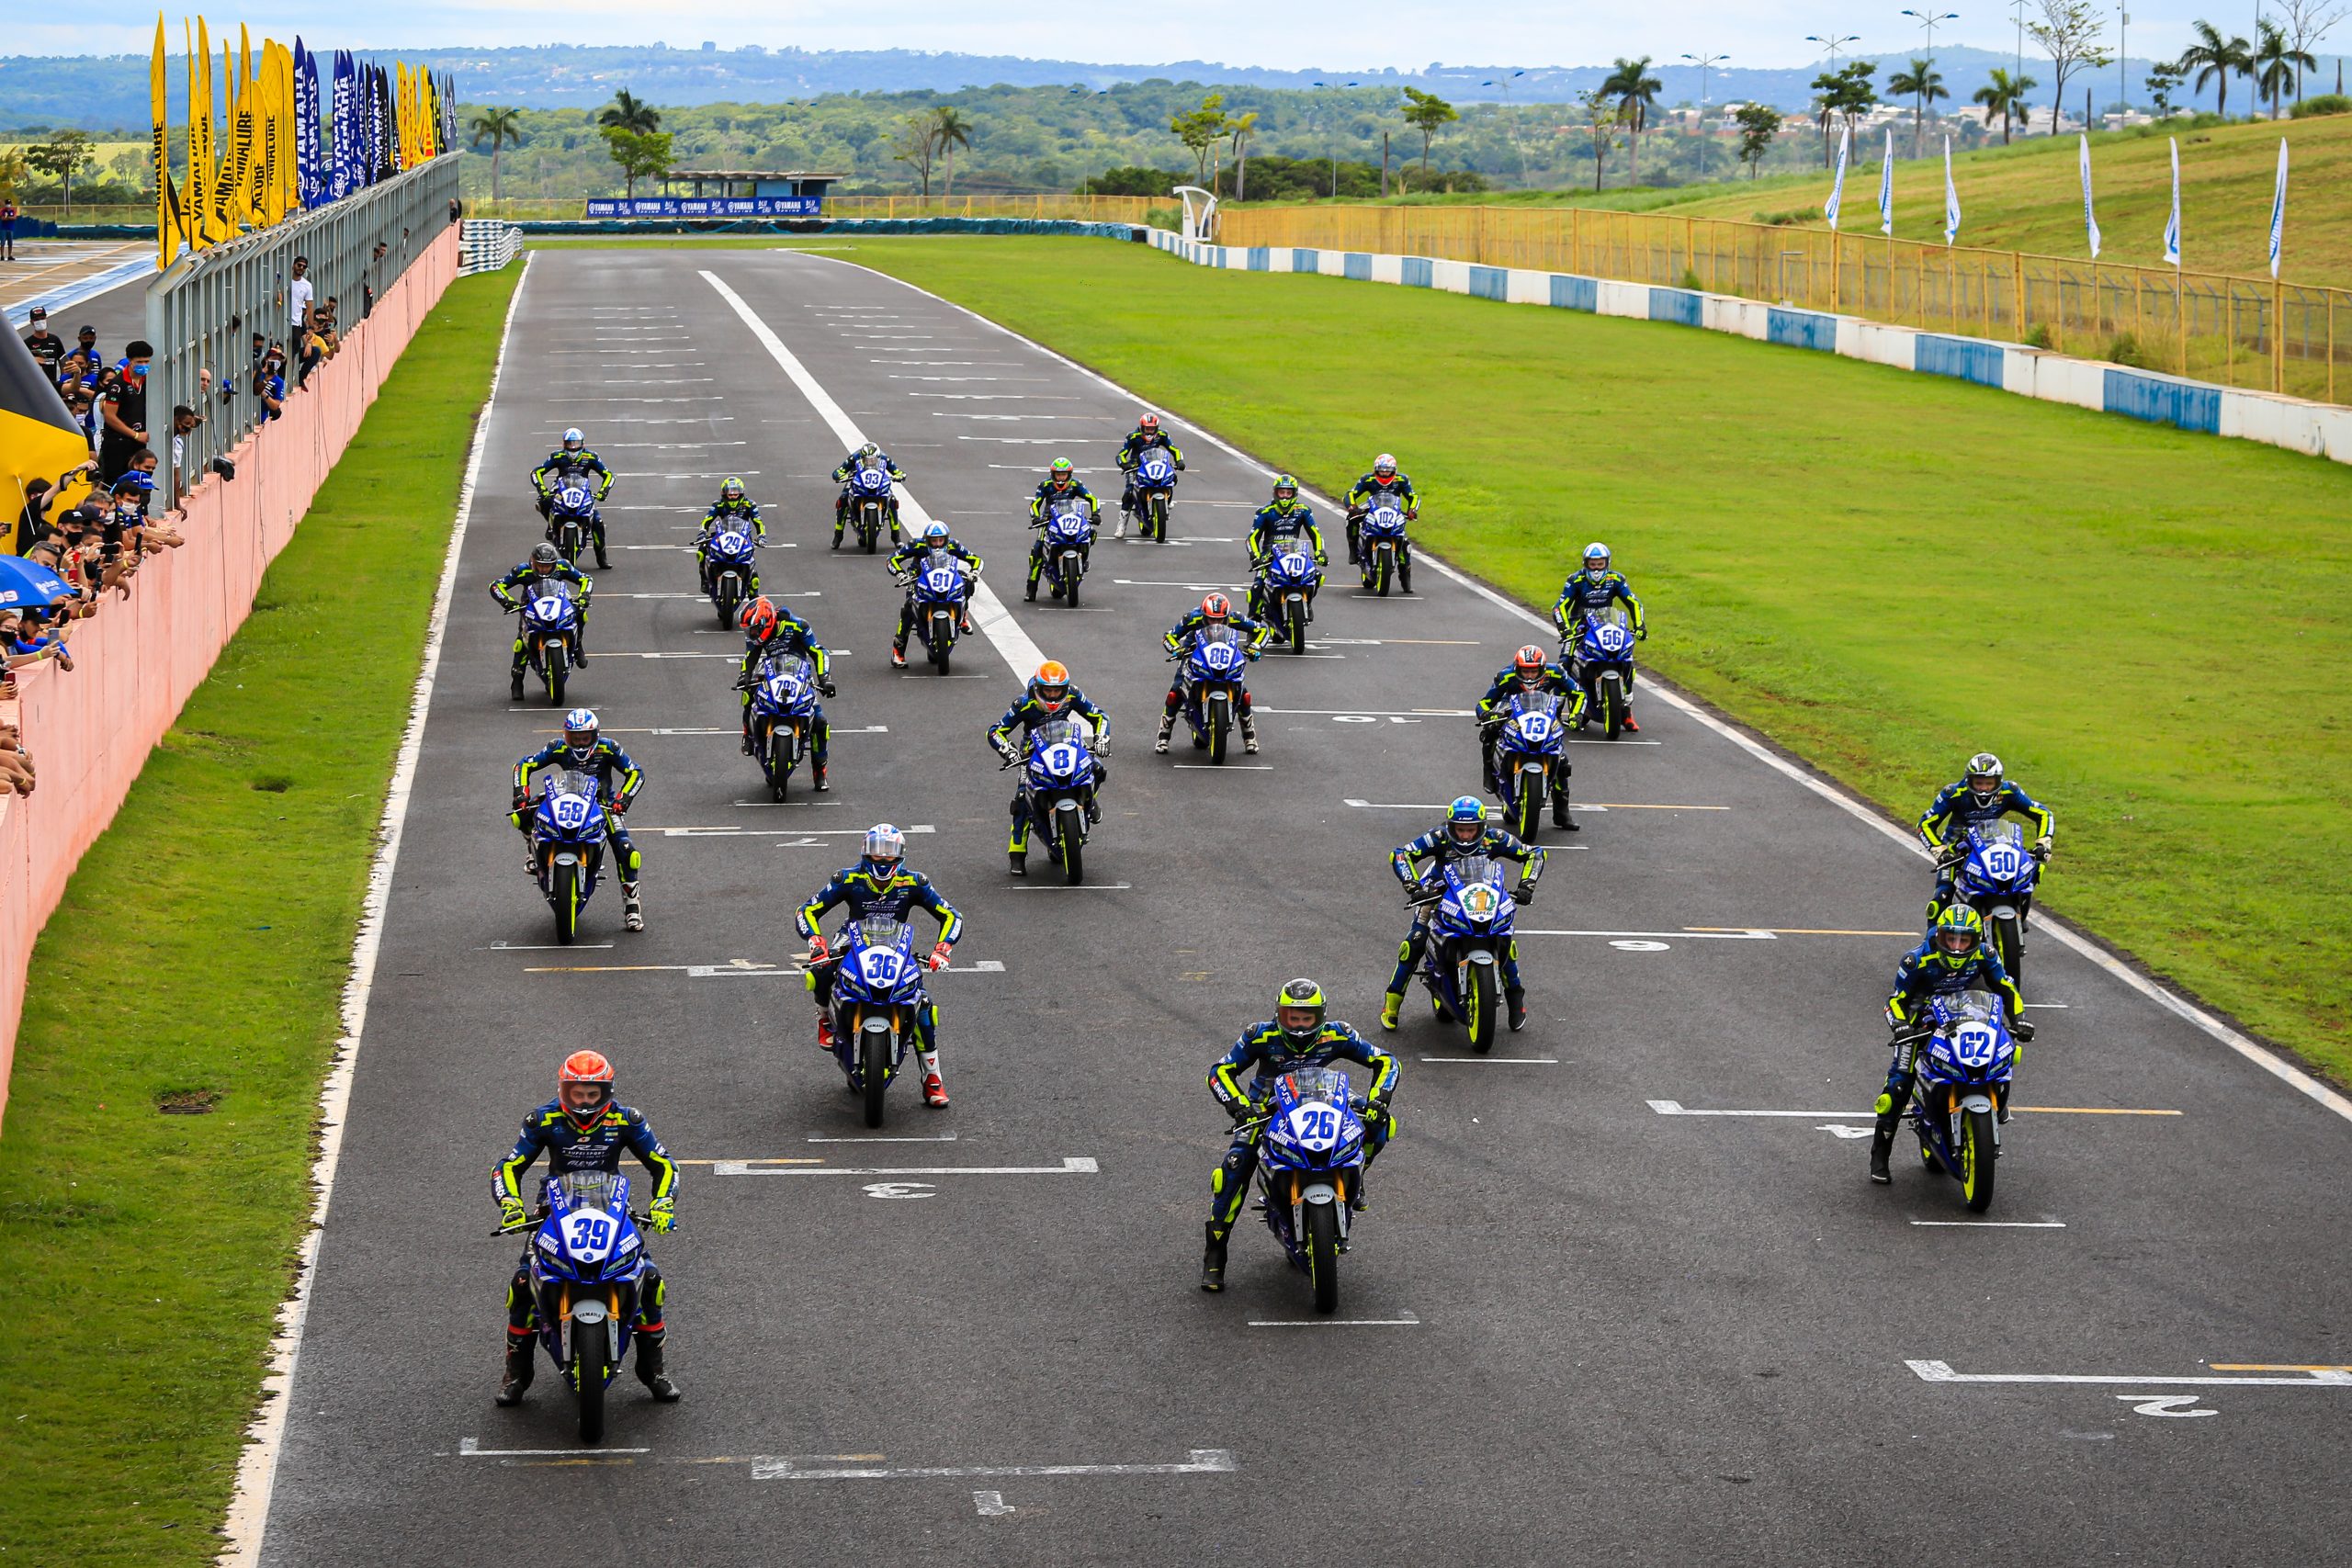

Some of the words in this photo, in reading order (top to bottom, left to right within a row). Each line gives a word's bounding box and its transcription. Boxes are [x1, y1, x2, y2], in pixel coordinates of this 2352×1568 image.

[641, 202, 661, 210] YAMAHA
[687, 202, 707, 210] YAMAHA
[734, 202, 753, 210] YAMAHA
[865, 473, 879, 484] 93
[1150, 465, 1163, 476] 17
[566, 491, 582, 503] 16
[1062, 518, 1078, 530] 122
[1379, 512, 1394, 524] 102
[724, 536, 741, 549] 24
[1286, 558, 1302, 570] 70
[933, 573, 949, 587] 91
[542, 601, 555, 615] 7
[1602, 630, 1621, 646] 56
[1210, 648, 1229, 664] 86
[1525, 716, 1546, 734] 13
[1054, 750, 1069, 770] 8
[559, 801, 583, 822] 58
[1990, 852, 2015, 874] 50
[1449, 871, 1460, 886] PS5
[1473, 891, 1488, 911] 1
[797, 914, 808, 934] ENEOS
[853, 929, 863, 946] PS5
[867, 953, 898, 979] 36
[841, 967, 857, 982] YAMAHA
[1960, 1032, 1990, 1058] 62
[1931, 1048, 1951, 1062] YAMAHA
[1338, 1073, 1346, 1094] PS5
[1280, 1084, 1294, 1107] PS5
[1301, 1111, 1335, 1141] 26
[1268, 1130, 1288, 1146] YAMAHA
[616, 1177, 627, 1200] PS5
[862, 1182, 936, 1199] 3
[553, 1189, 565, 1210] PS5
[571, 1218, 610, 1250] 39
[538, 1237, 559, 1255] YAMAHA
[2115, 1394, 2218, 1417] 2
